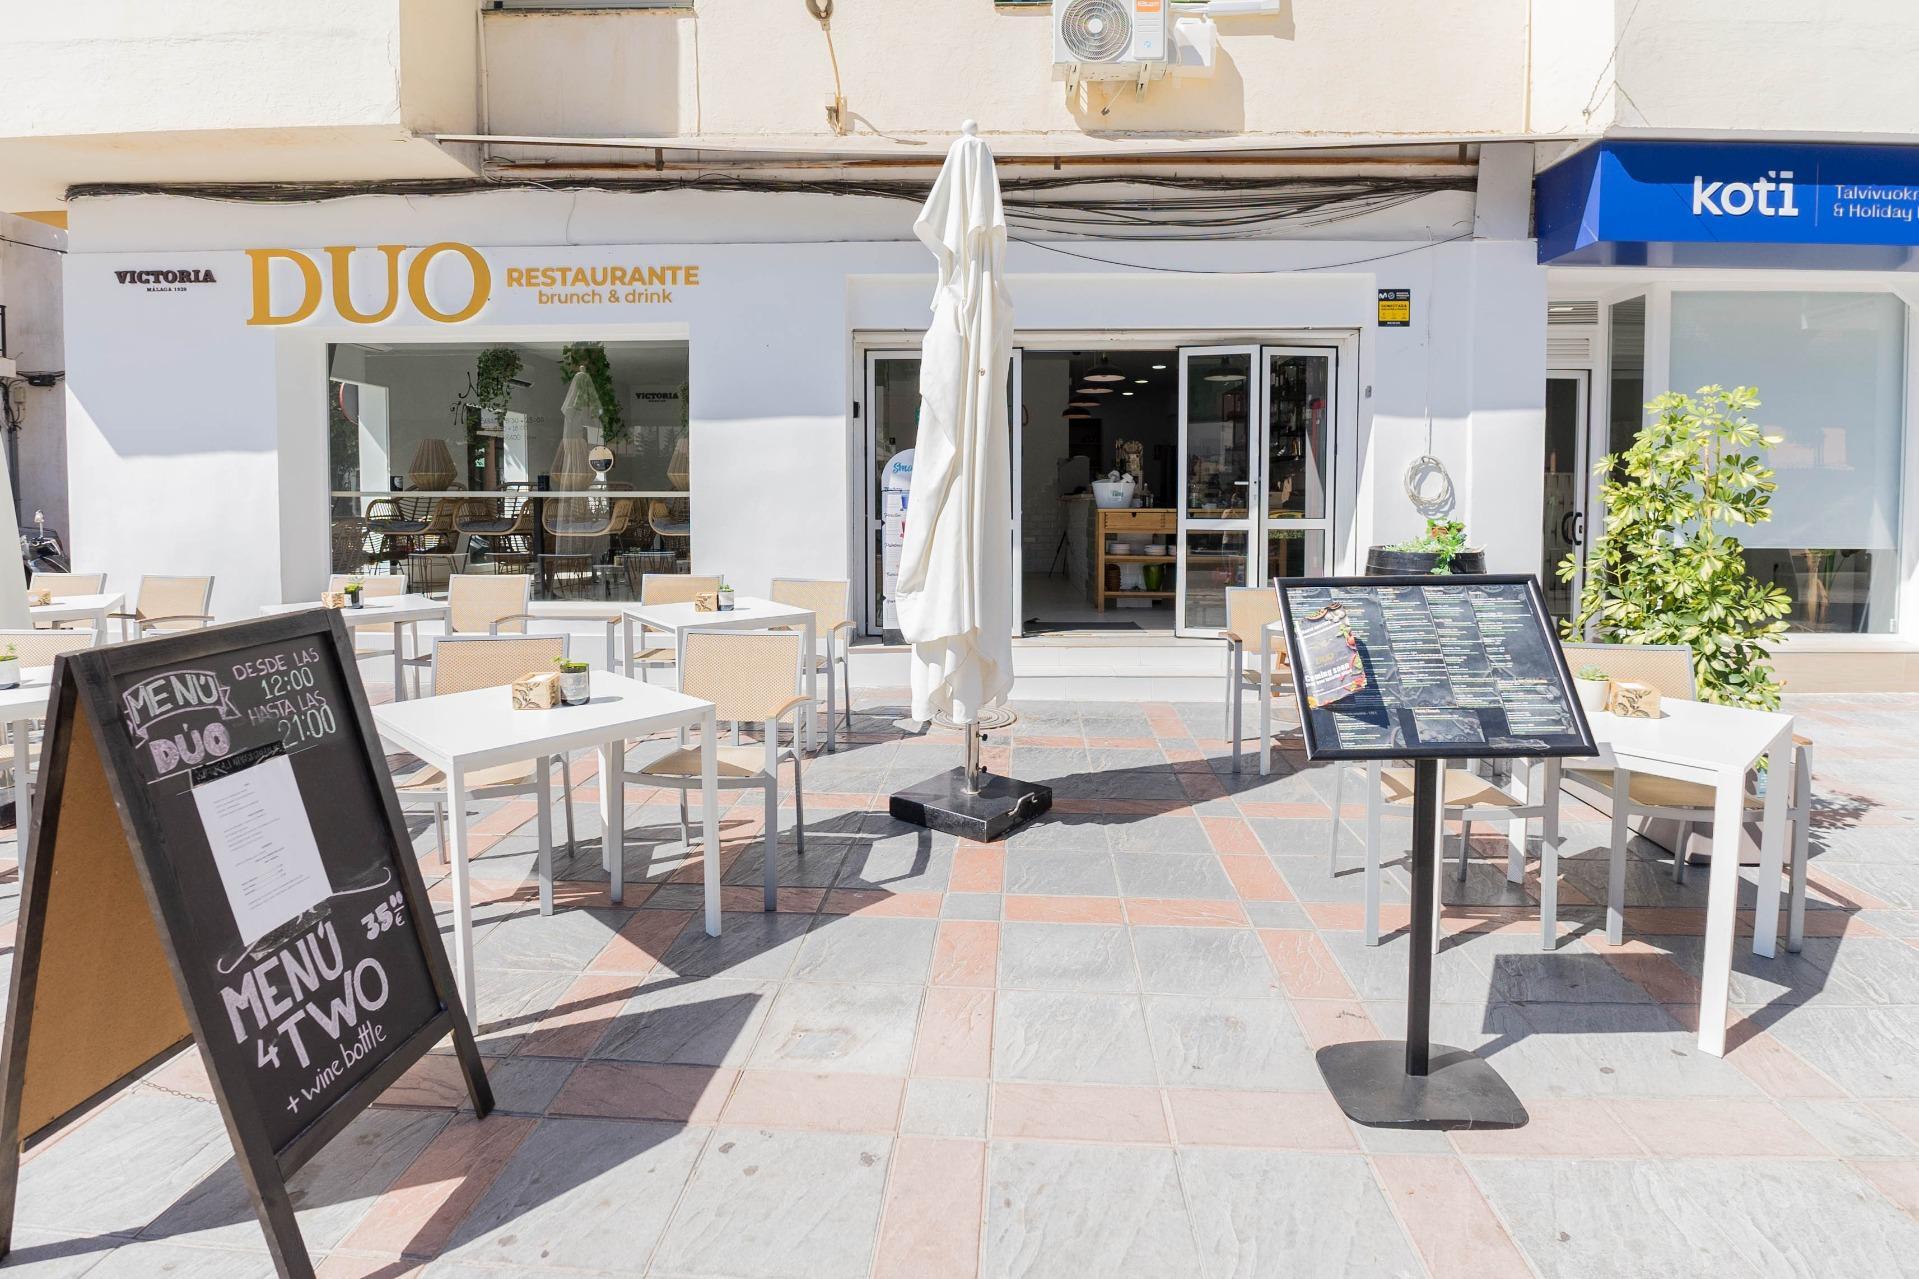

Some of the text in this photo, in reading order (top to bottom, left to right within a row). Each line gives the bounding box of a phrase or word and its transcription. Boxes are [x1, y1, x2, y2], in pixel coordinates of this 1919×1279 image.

[1693, 169, 1798, 217] koti
[1833, 202, 1913, 222] & Holiday
[114, 269, 217, 284] VICTORIA
[245, 241, 491, 326] DUO
[507, 266, 700, 288] RESTAURANTE
[538, 288, 673, 305] brunch & drink
[635, 392, 679, 400] VICTORIA
[232, 647, 320, 681] DESDE LAS
[127, 673, 219, 724] MENÚ
[261, 667, 314, 700] 12:00
[248, 690, 327, 727] HASTA LAS
[278, 704, 336, 749] 21:00
[149, 723, 231, 774] DÚO
[219, 921, 344, 1044] MENÚ
[301, 1059, 343, 1101] wine
[340, 1020, 387, 1069] bottle
